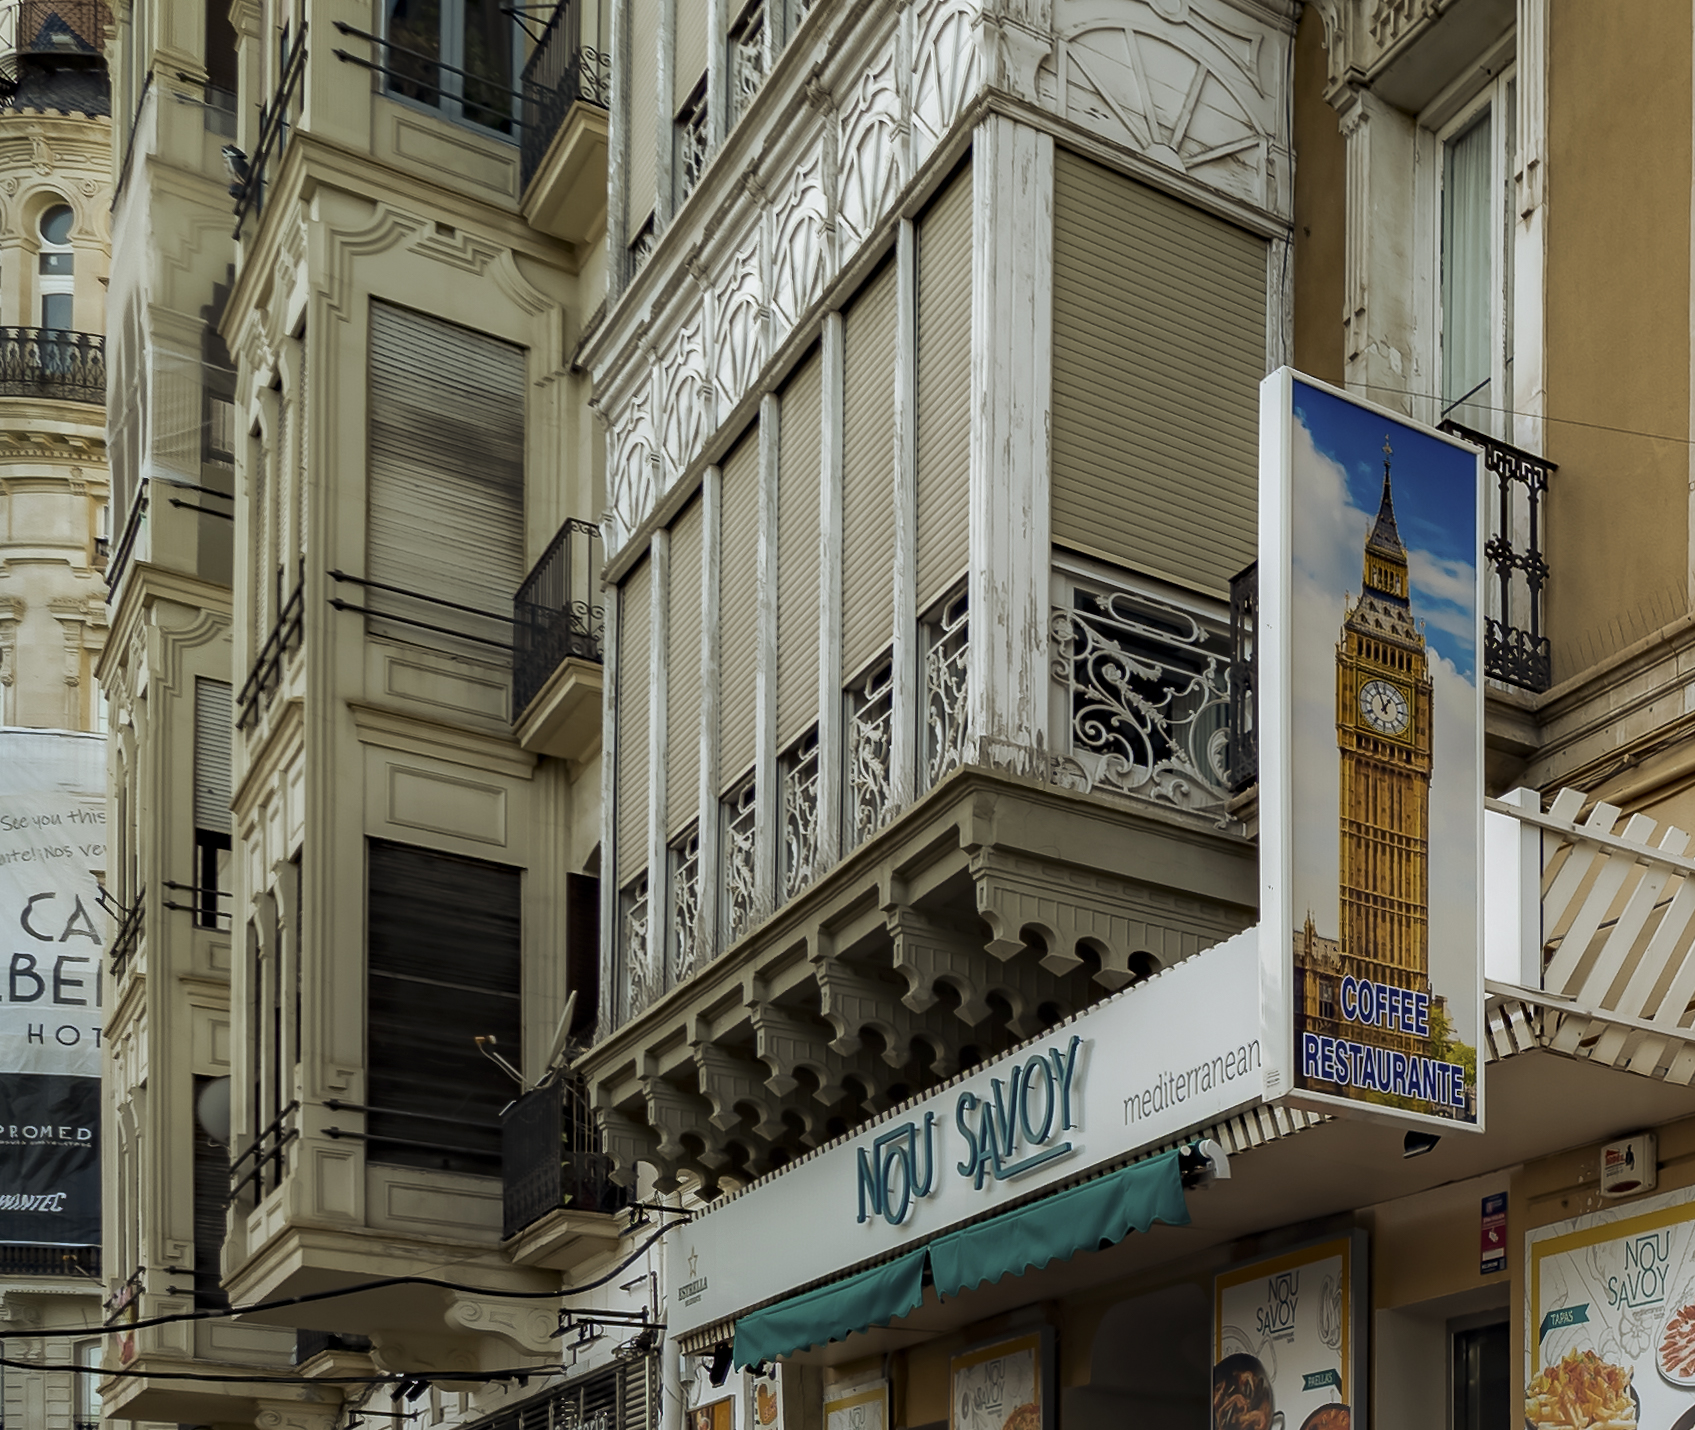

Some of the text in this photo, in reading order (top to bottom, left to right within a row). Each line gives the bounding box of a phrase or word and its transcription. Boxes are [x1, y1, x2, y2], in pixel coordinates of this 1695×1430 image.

[0, 809, 106, 831] See you this
[0, 953, 102, 1007] BE
[1340, 974, 1430, 1037] COFFEE
[1302, 1032, 1465, 1108] RESTAURANTE
[856, 1035, 1262, 1225] NOU SAVOY mediterranean
[1624, 1231, 1670, 1270] NOU
[1267, 1270, 1300, 1303] NOU
[1607, 1264, 1670, 1311] SAVOY
[1256, 1297, 1299, 1336] SAVOY
[1550, 1310, 1574, 1326] TAPAS
[1307, 1371, 1333, 1387] PAELLAS
